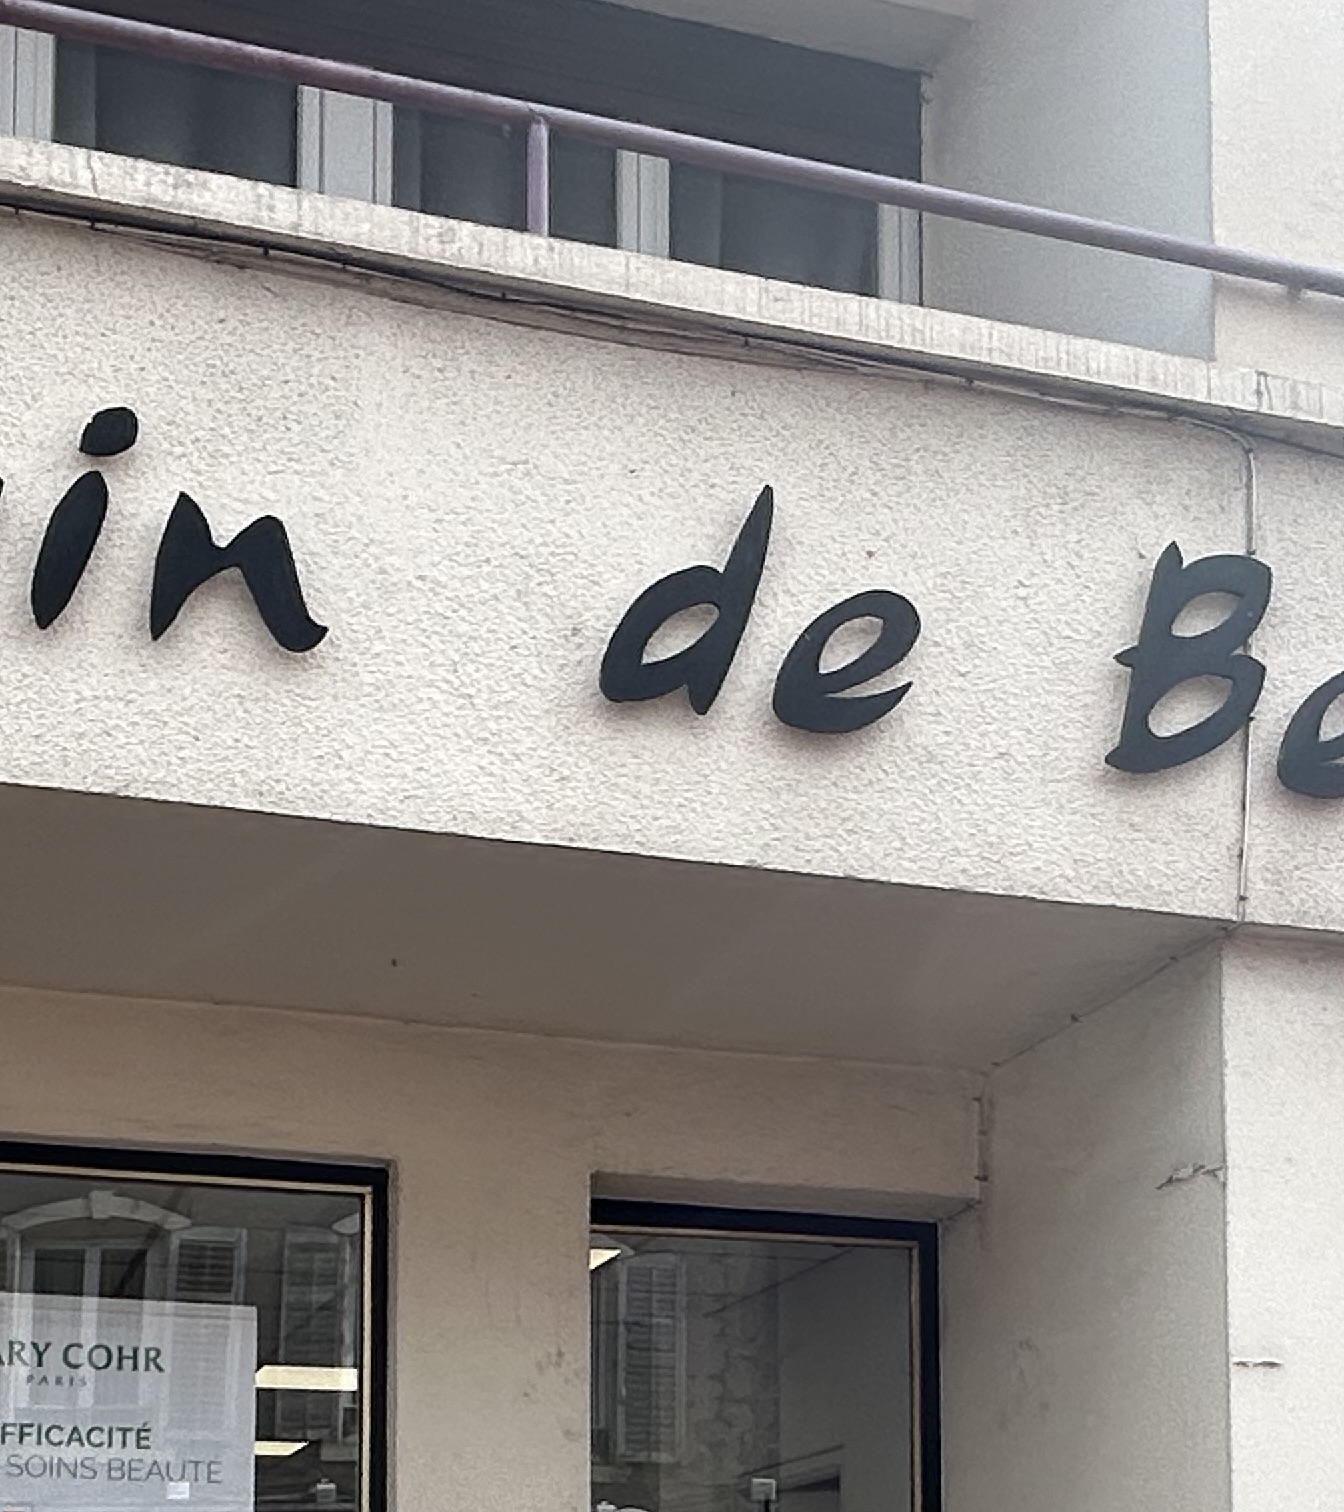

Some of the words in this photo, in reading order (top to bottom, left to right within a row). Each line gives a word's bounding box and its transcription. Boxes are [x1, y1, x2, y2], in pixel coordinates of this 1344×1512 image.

[598, 484, 921, 733] de
[62, 1343, 164, 1372] COHR
[26, 1375, 87, 1387] PARIS
[4, 1454, 98, 1480] SOINS
